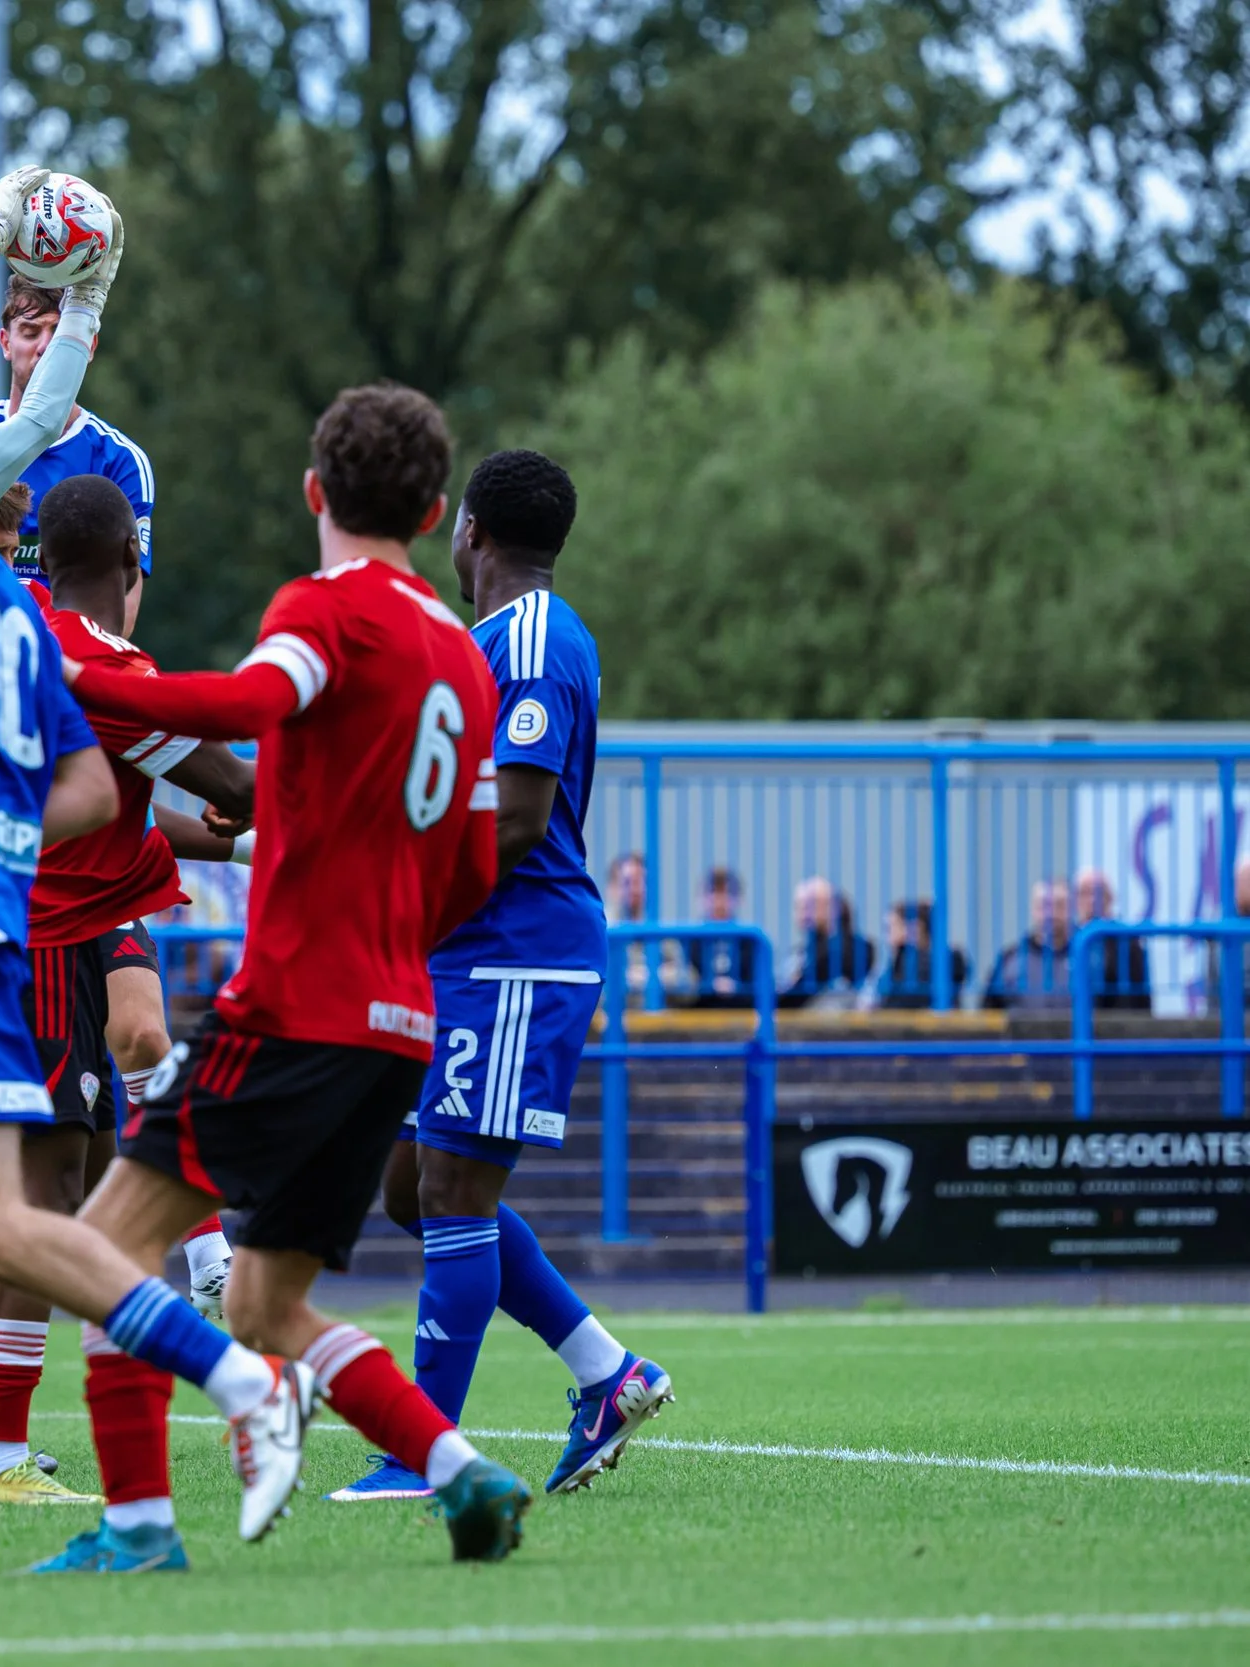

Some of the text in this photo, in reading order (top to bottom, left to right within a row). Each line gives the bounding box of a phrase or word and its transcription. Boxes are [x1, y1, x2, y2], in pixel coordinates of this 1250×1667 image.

[43, 186, 55, 220] Mitre
[516, 713, 535, 731] B
[404, 679, 465, 832] 6
[445, 1028, 478, 1090] 2
[966, 1134, 1059, 1170] BEAU
